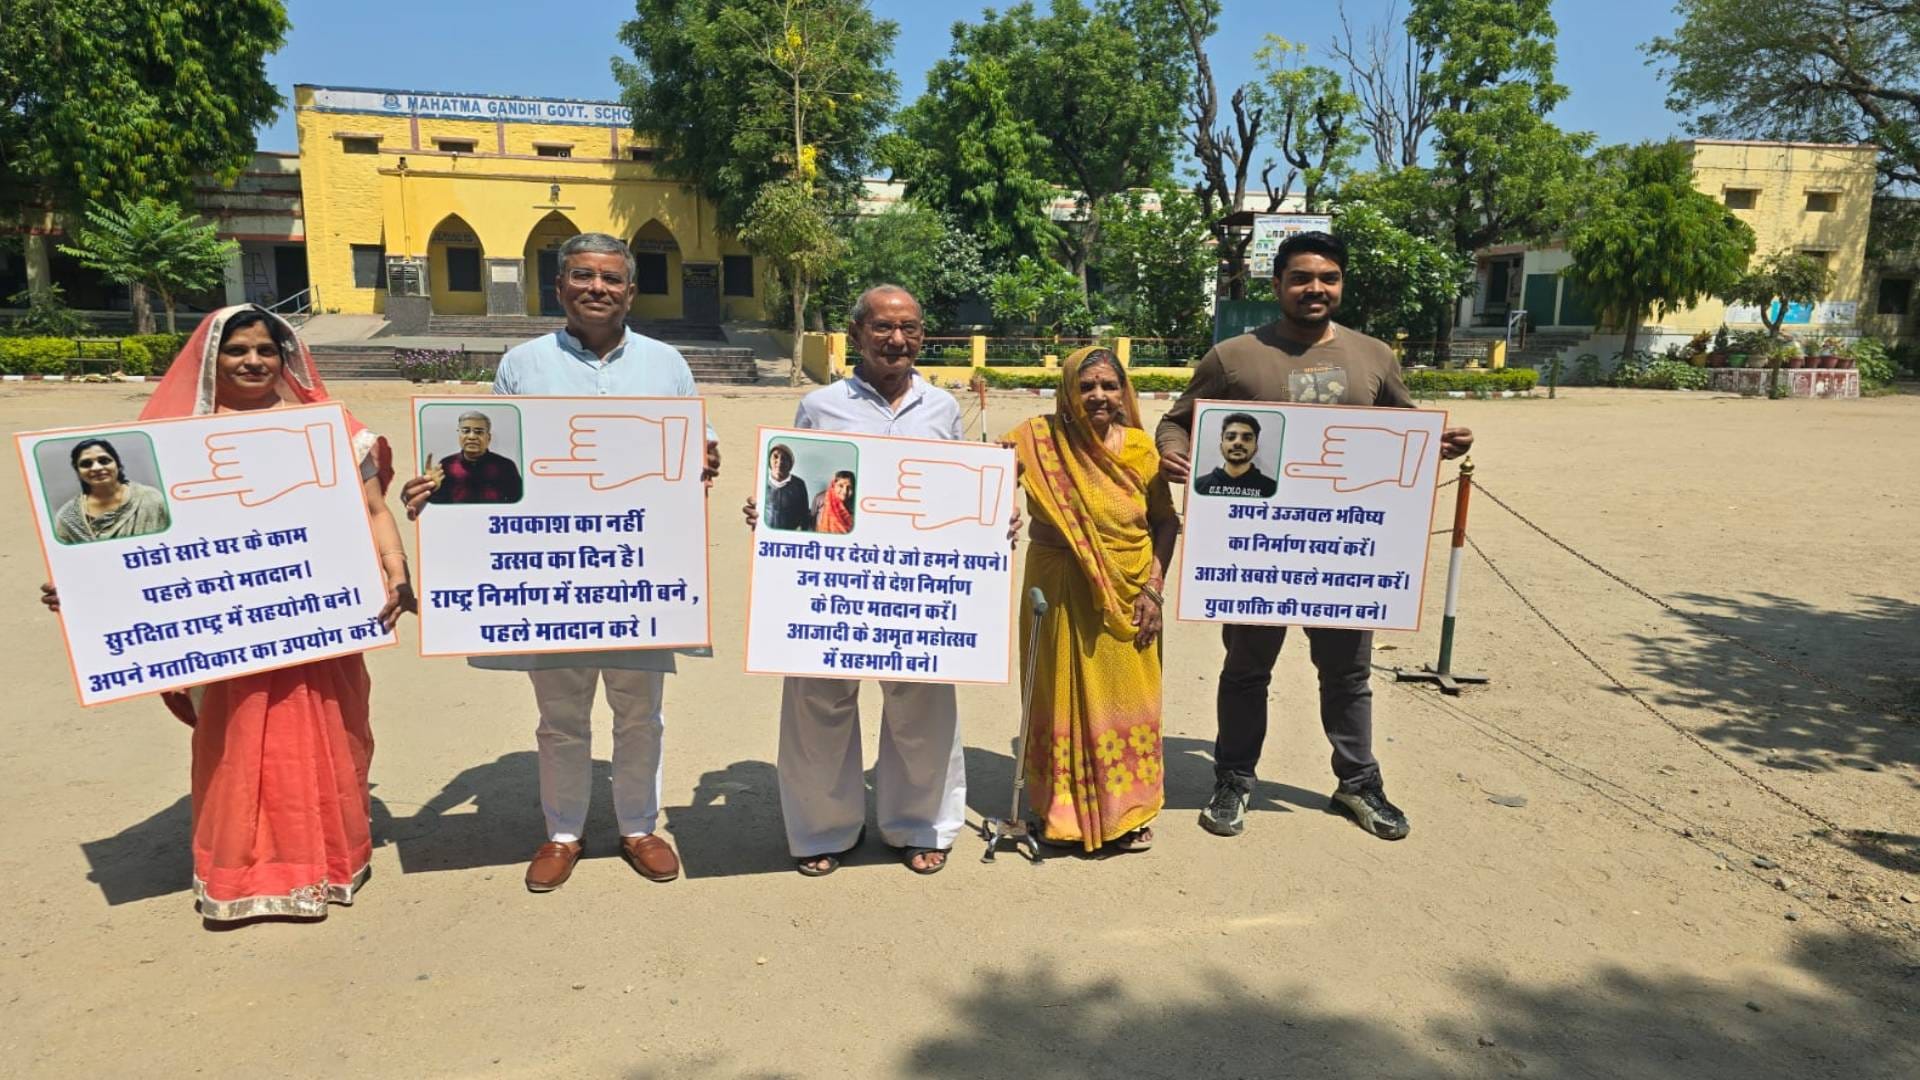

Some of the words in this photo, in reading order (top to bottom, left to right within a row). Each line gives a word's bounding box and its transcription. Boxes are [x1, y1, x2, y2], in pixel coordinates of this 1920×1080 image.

[407, 96, 482, 113] MAHATMA
[487, 102, 541, 116] GANDHI
[547, 104, 589, 118] GOVT.
[594, 106, 632, 121] SCHO
[488, 515, 571, 535] अवकाश
[574, 514, 603, 533] का
[605, 507, 646, 533] नहीं
[1227, 501, 1270, 521] अपने
[1271, 506, 1334, 523] उज्जवल
[1336, 505, 1386, 526] भविष्य
[173, 536, 211, 562] सारे
[212, 536, 242, 556] घर
[242, 529, 264, 551] के
[265, 526, 308, 547] काम
[758, 540, 823, 561] आजादी
[824, 545, 847, 562] पर
[848, 542, 881, 565] देखे
[898, 547, 921, 567] जो
[923, 549, 961, 570] हमने
[1228, 536, 1252, 552] का
[1252, 532, 1308, 554] निर्माण
[1308, 536, 1344, 556] स्वयं
[489, 551, 545, 571] उत्सव
[546, 550, 577, 570] का
[578, 545, 617, 569] दिन
[141, 576, 193, 604] पहले
[195, 570, 236, 595] करो
[797, 570, 821, 587] उन
[823, 569, 872, 590] सपनों
[871, 570, 887, 591] से
[888, 573, 916, 593] देश
[917, 573, 973, 596] निर्माण
[1194, 563, 1239, 583] आओ
[1240, 564, 1280, 585] सबसे
[1280, 567, 1320, 586] पहले
[1321, 571, 1377, 589] मतदान
[430, 589, 474, 612] राष्ट्र
[477, 581, 551, 607] निर्माण
[552, 580, 573, 605] में
[573, 579, 654, 605] सहयोगी
[810, 596, 829, 615] के
[830, 594, 865, 616] लिए
[867, 600, 922, 619] मतदान
[1204, 598, 1236, 619] युवा
[1236, 596, 1275, 616] शक्ति
[1276, 597, 1300, 617] की
[1300, 602, 1354, 619] पहचान
[103, 621, 180, 656] सुरक्षित
[181, 613, 224, 637] राष्ट्र
[224, 603, 244, 628] में
[245, 593, 321, 624] सहयोगी
[479, 617, 532, 643] पहले
[534, 621, 606, 641] मतदान
[786, 621, 850, 642] आजादी
[852, 622, 871, 643] के
[872, 627, 917, 651] अमृत
[916, 626, 978, 649] महोत्सव
[88, 661, 145, 694] अपने
[146, 646, 250, 680] मताधिकार
[249, 639, 279, 660] का
[279, 626, 343, 655] उपयोग
[823, 647, 838, 668] में
[839, 650, 904, 672] सहभागी
